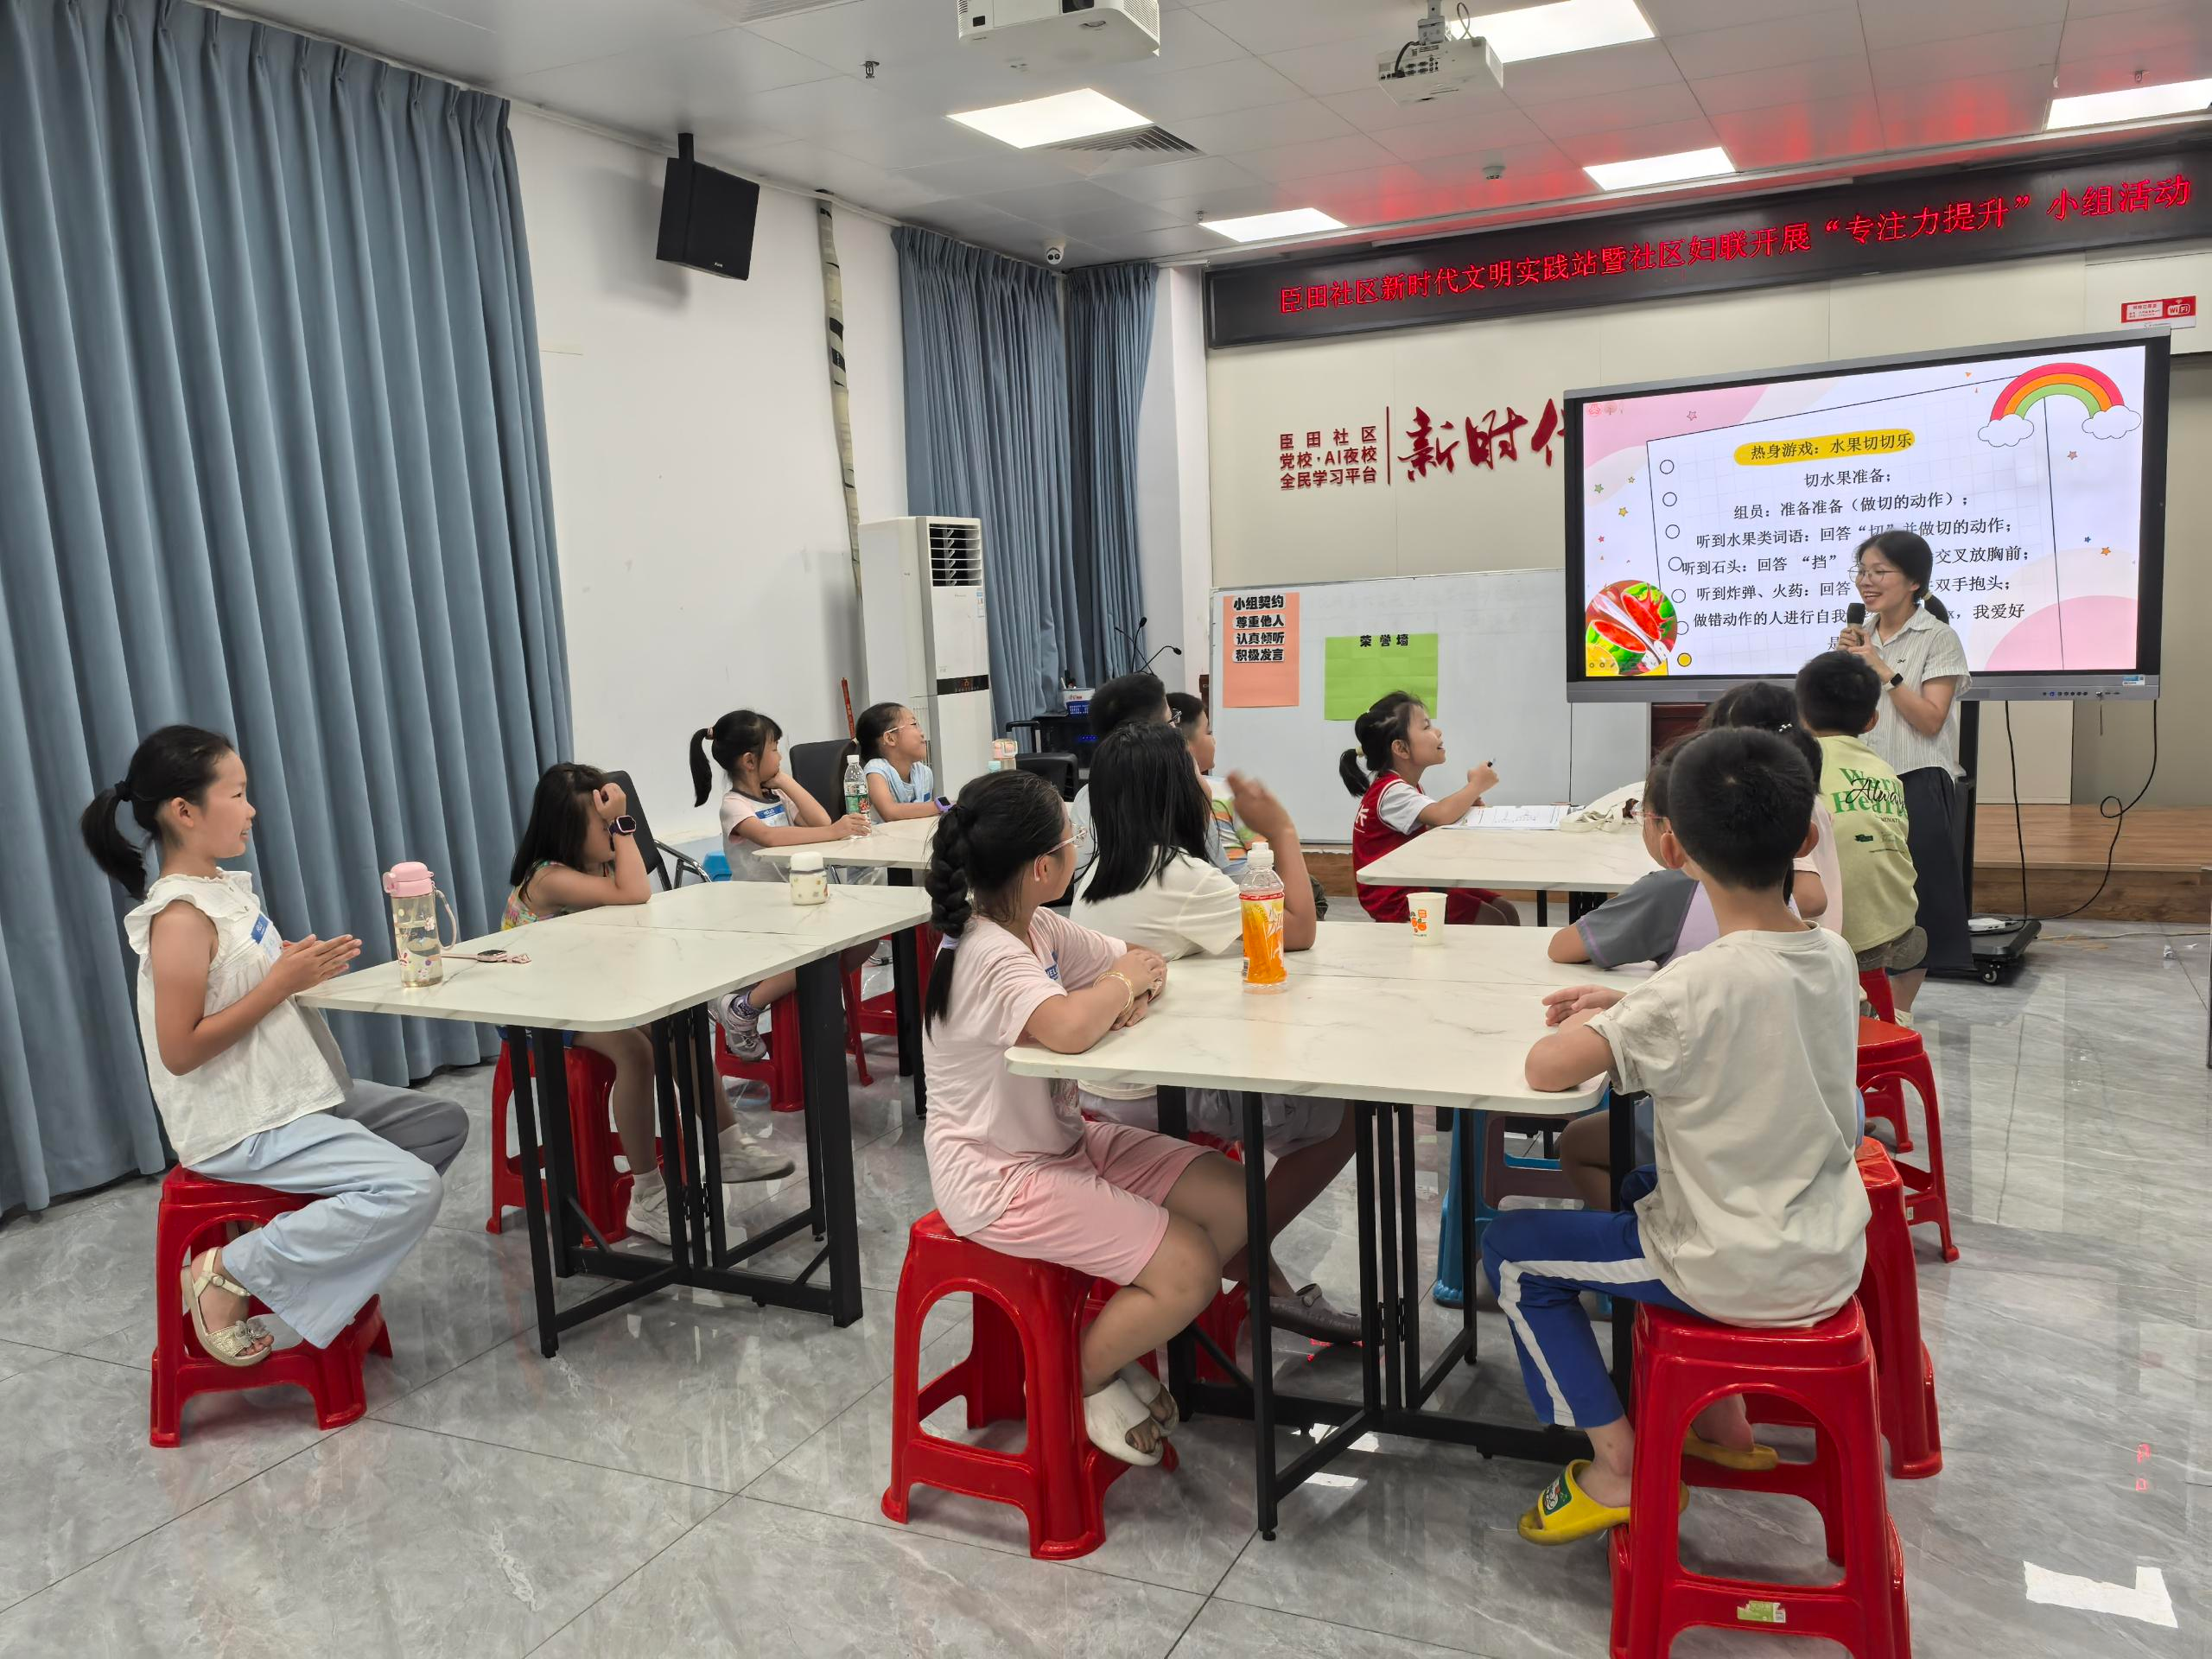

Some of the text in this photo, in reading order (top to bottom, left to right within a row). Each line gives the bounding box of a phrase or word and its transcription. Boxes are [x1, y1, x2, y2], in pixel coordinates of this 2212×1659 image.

[1280, 425, 1377, 450] 臣田社区
[1751, 432, 1912, 461] 热身游戏：水果切切乐
[1280, 465, 1378, 491] 全民学习平台
[1803, 468, 1891, 488] 切水果准备；
[1928, 575, 2011, 593] 双手抱头；
[1233, 594, 1285, 611] 小组契约
[1236, 614, 1285, 629] 尊重他人
[1236, 632, 1285, 645] 认真倾听
[1359, 633, 1409, 648] 荣誉墙
[1235, 648, 1284, 662] 积极发言
